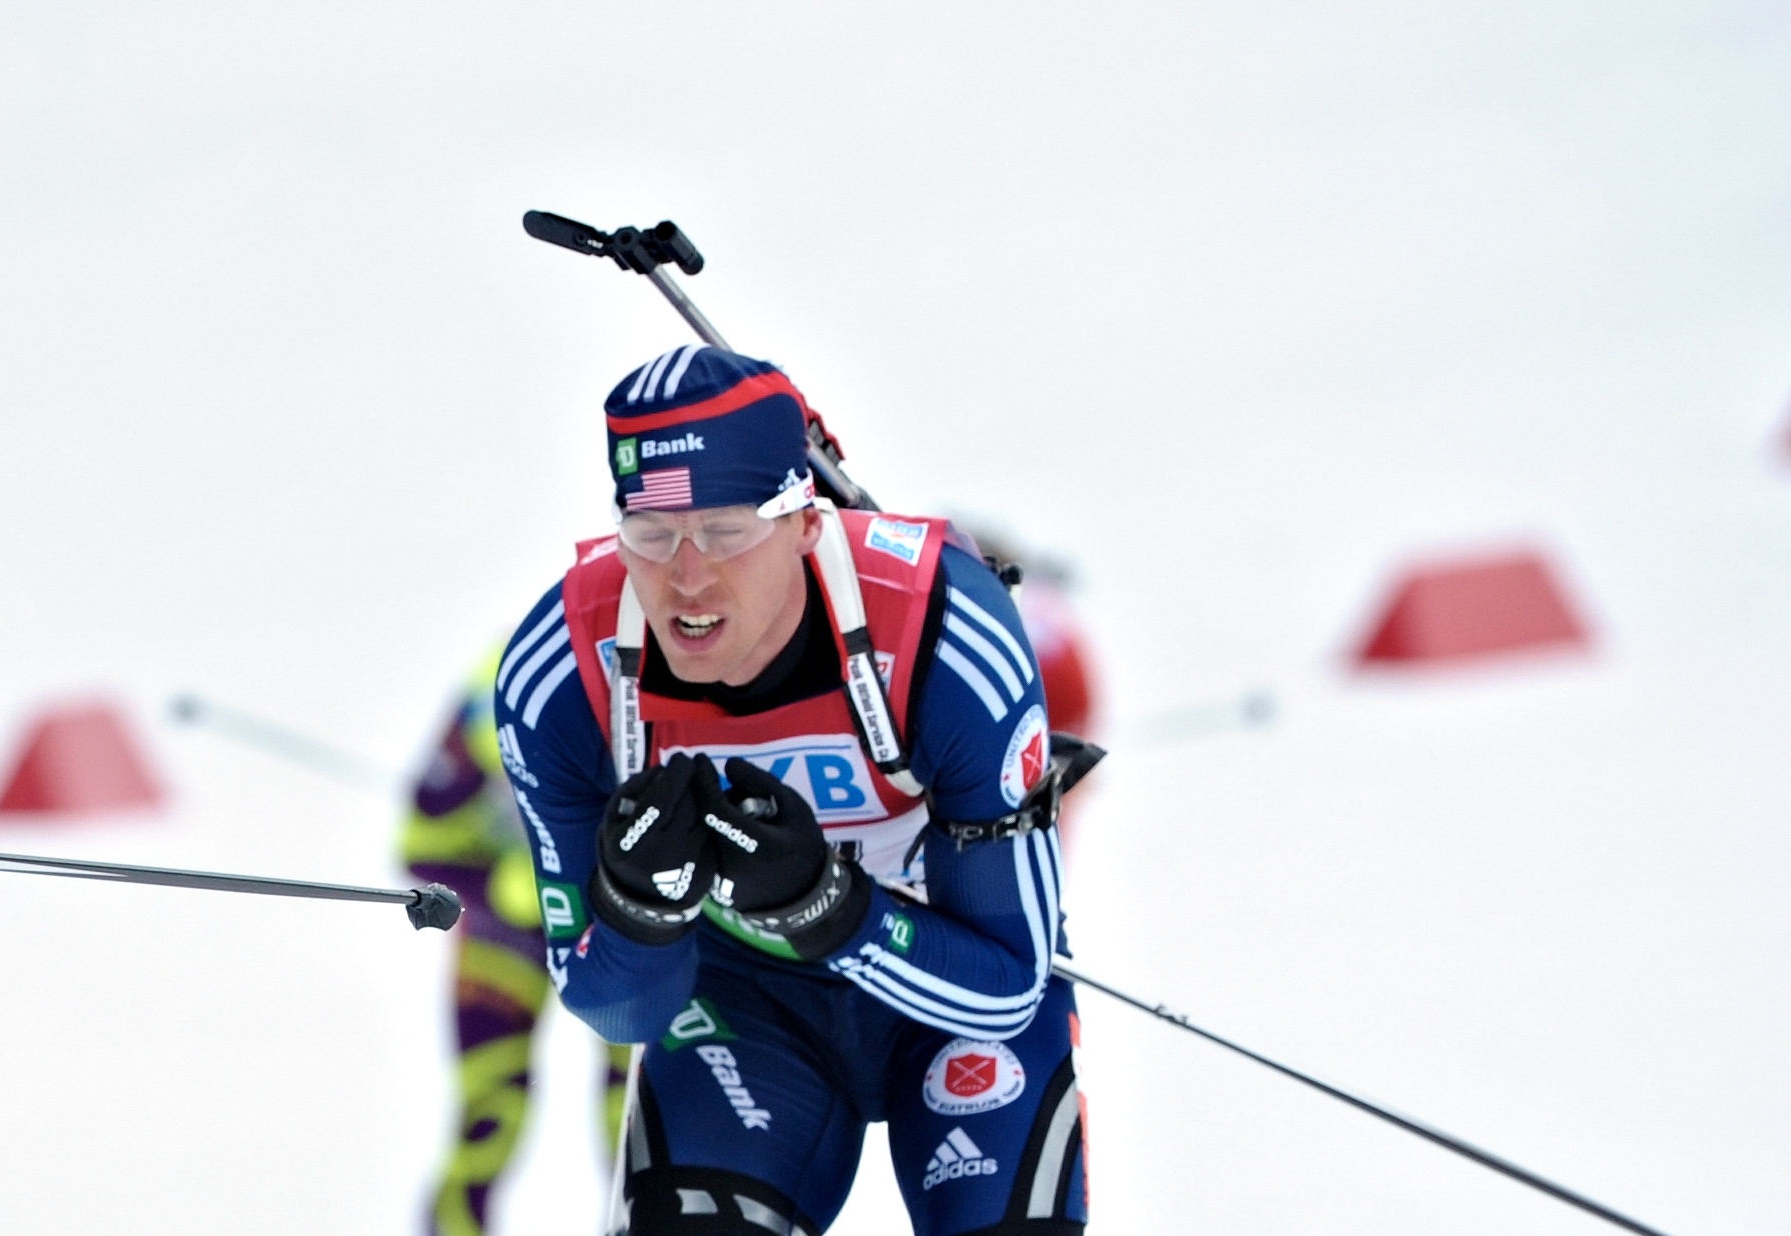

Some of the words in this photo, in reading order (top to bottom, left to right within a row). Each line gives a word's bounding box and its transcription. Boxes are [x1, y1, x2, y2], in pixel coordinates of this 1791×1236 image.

[641, 433, 705, 459] Bank
[620, 806, 660, 851] adidas
[705, 803, 758, 853] adidas
[695, 1045, 772, 1131] Bank
[923, 1158, 999, 1191] adidas
